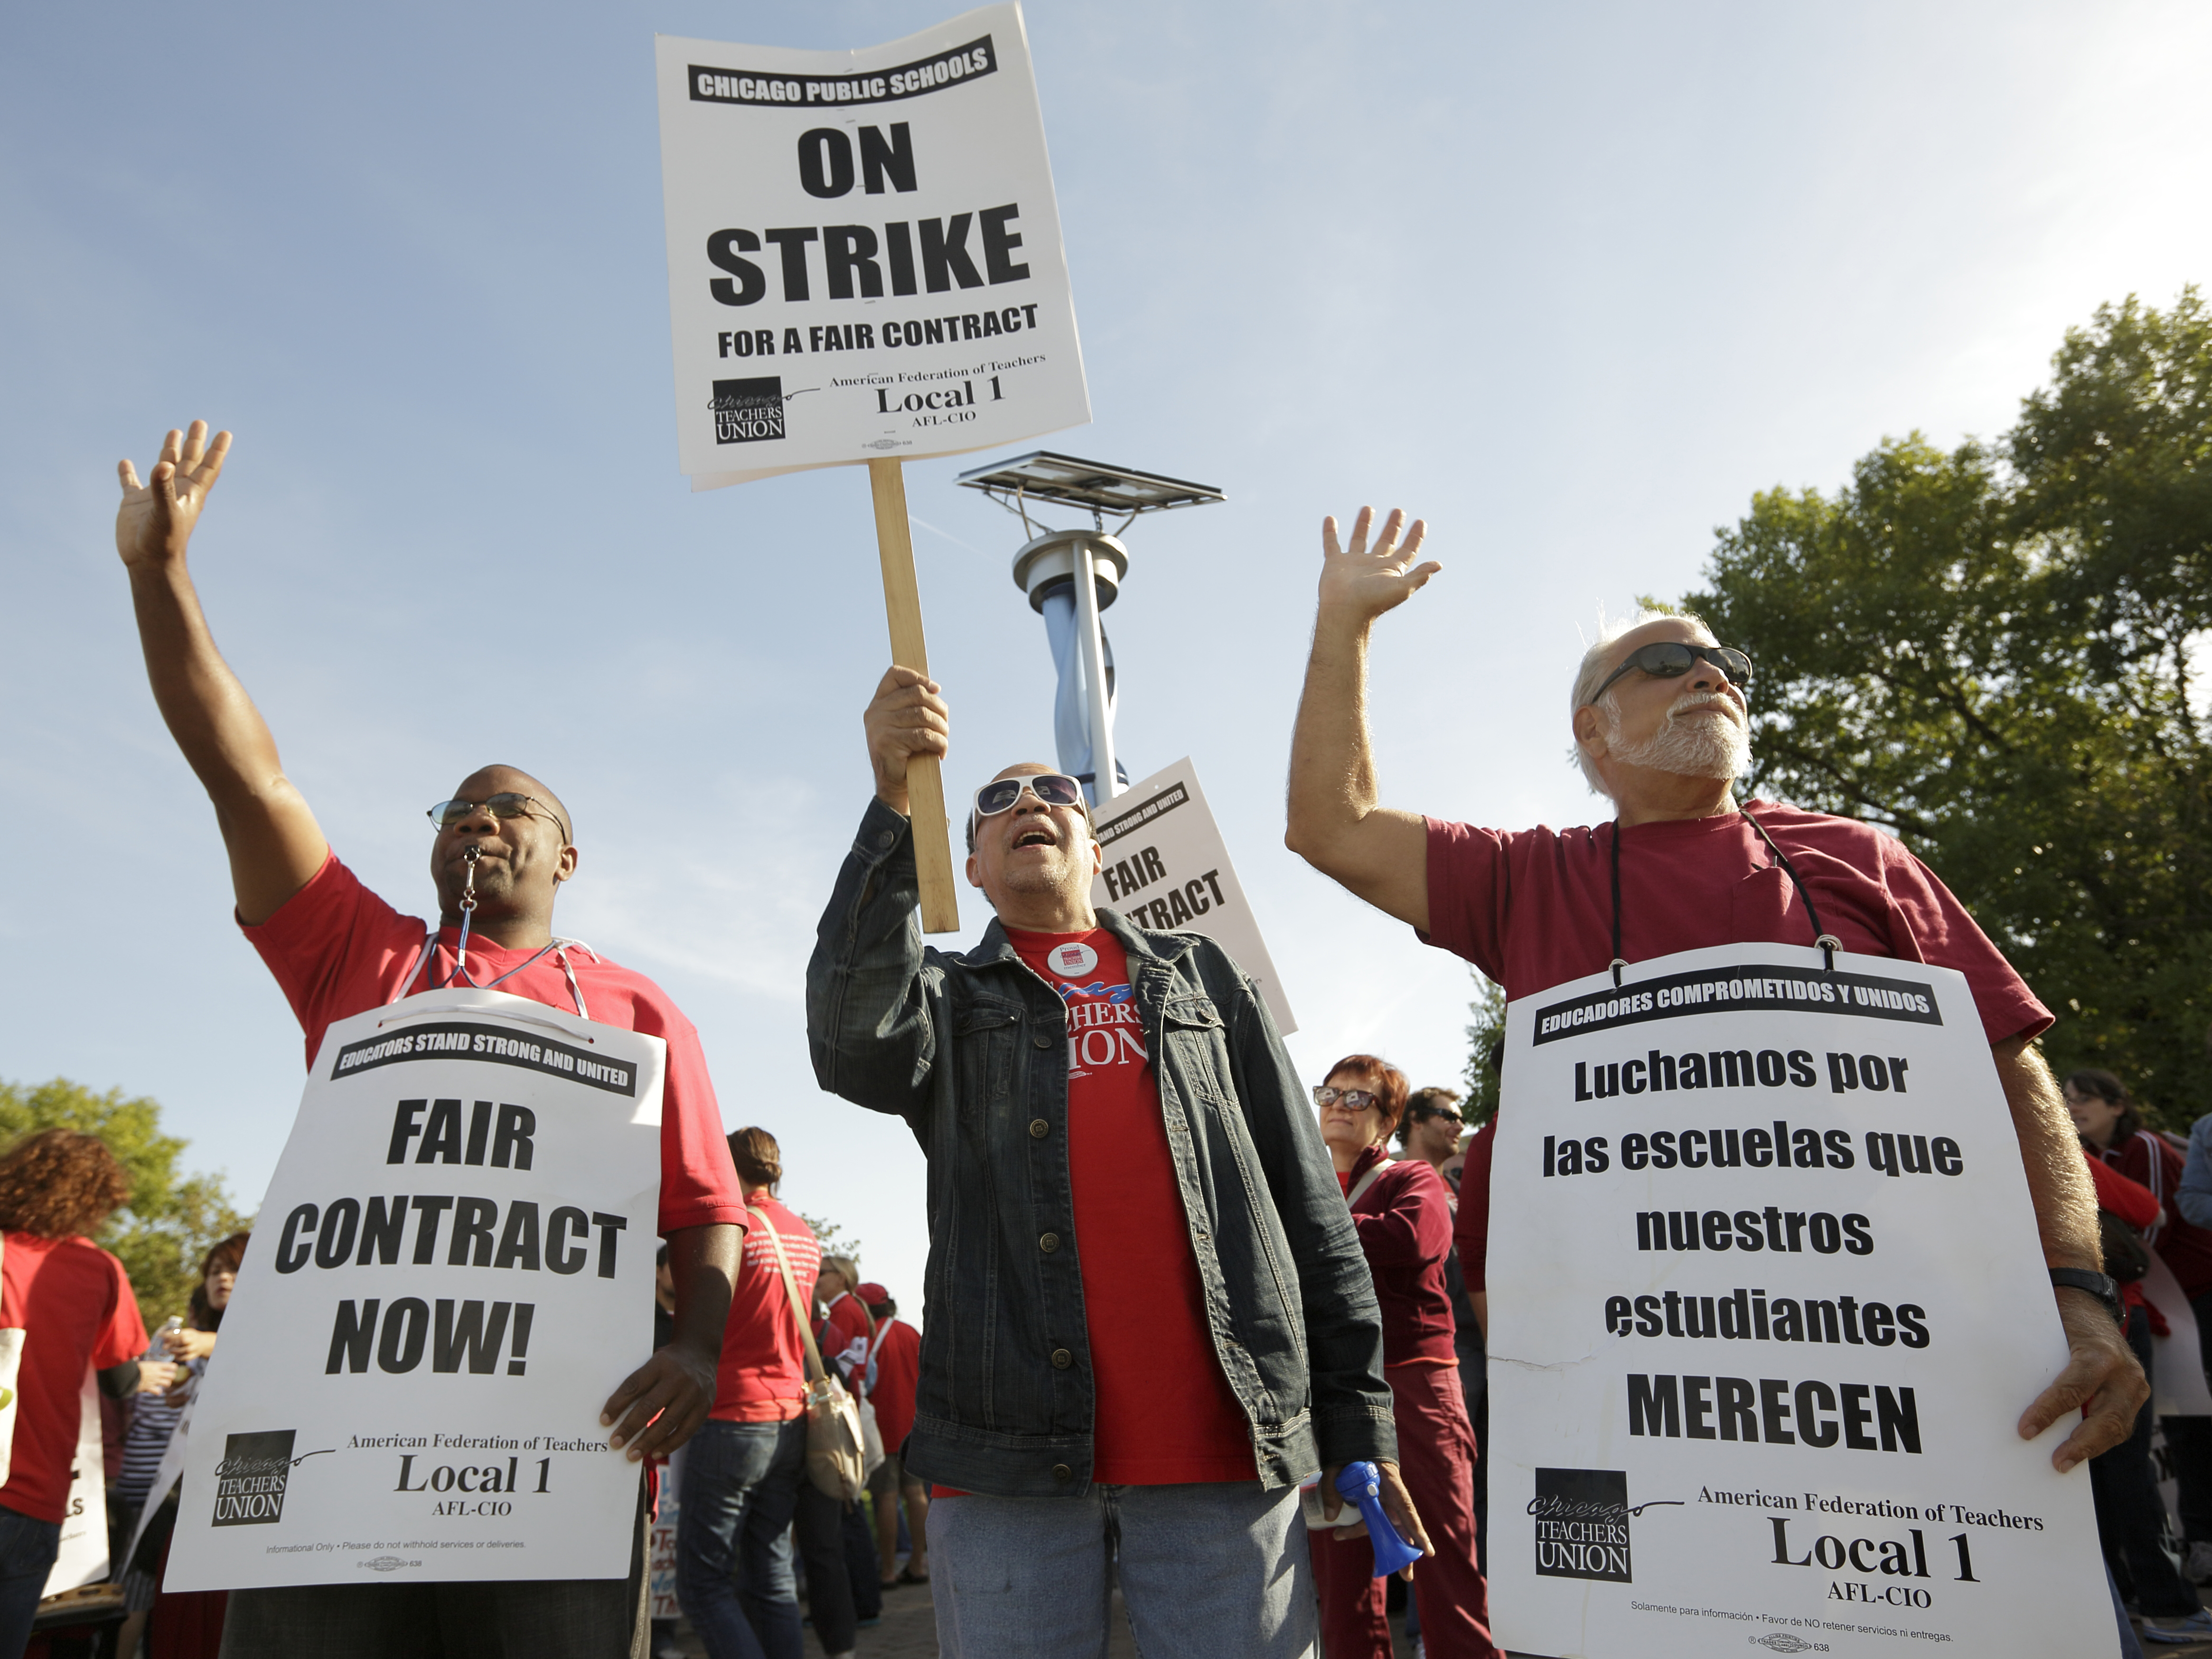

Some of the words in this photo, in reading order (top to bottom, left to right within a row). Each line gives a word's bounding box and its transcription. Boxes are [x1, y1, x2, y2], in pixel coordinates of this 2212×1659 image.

[697, 73, 801, 102] CHICAGO
[806, 77, 886, 102] PUBLIC
[890, 47, 989, 92] SCHOOLS
[797, 122, 918, 199] ON
[706, 202, 1031, 307] STRIKE
[718, 329, 775, 358] FOR
[783, 328, 803, 354] A
[809, 323, 875, 352] FAIR
[882, 303, 1038, 348] CONTRACT
[829, 375, 894, 388] American
[898, 366, 970, 384] Federation
[972, 363, 986, 375] of
[988, 353, 1047, 372] Teachers
[715, 406, 783, 423] TEACHERS
[876, 376, 976, 414] Local
[989, 375, 1006, 402] 1
[717, 419, 783, 440] UNION
[912, 410, 976, 428] AFL-CIO
[1114, 812, 1143, 834] STRONG
[1142, 803, 1158, 820] AND
[1156, 789, 1184, 811] UNITED
[1102, 846, 1167, 902] FAIR
[1125, 868, 1226, 929] TRACT
[1540, 994, 1653, 1035] EDUCADORES
[1657, 979, 1835, 1009] COMPROMETIDOS
[1837, 984, 1851, 1005] Y
[1853, 985, 1930, 1014] UNIDOS
[338, 1036, 414, 1071] EDUCATORS
[415, 1033, 470, 1052] STAND
[473, 1035, 542, 1062] STRONG
[542, 1048, 574, 1071] AND
[576, 1059, 629, 1087] UNITED
[1574, 1049, 1817, 1102] Luchamos
[1826, 1052, 1909, 1094] por
[386, 1099, 537, 1171] FAIR
[1543, 1134, 1610, 1177] las
[1620, 1120, 1855, 1171] escuelas
[1866, 1131, 1964, 1177] que
[275, 1195, 628, 1280] CONTRACT
[1636, 1206, 1874, 1256] nuestros
[325, 1297, 535, 1377] NOW!
[1604, 1288, 1931, 1349] estudiantes
[1626, 1373, 1922, 1454] MERECEN
[347, 1433, 427, 1449] American
[432, 1434, 518, 1450] Federation
[524, 1436, 540, 1451] of
[542, 1436, 608, 1452] Teachers
[220, 1475, 286, 1495] TEACHERS
[393, 1454, 518, 1493] Local
[532, 1457, 551, 1493] 1
[216, 1493, 283, 1520] UNION
[431, 1500, 512, 1516] AFL-CIO
[1527, 1494, 1685, 1526] Chicago
[1697, 1485, 1799, 1510] American
[1803, 1492, 1919, 1519] Federation
[1924, 1504, 1946, 1522] of
[1950, 1505, 2044, 1531] Teachers
[266, 1544, 314, 1554] Informational
[316, 1542, 335, 1553] Only
[342, 1542, 371, 1550] Please
[487, 1540, 526, 1548] deliveries.
[1537, 1520, 1627, 1545] TEACHERS
[1767, 1517, 1931, 1578] Local
[1948, 1532, 1981, 1583] 1
[1537, 1541, 1628, 1574] UNION
[1827, 1581, 1932, 1608] AFL-CIO
[1631, 1601, 1677, 1613] Solamente
[1679, 1607, 1699, 1616] para
[1701, 1608, 1753, 1622] información
[1762, 1613, 1788, 1625] Favor
[1790, 1617, 1802, 1626] de
[1804, 1618, 1820, 1628] NO
[1822, 1621, 1856, 1632] retener
[1857, 1624, 1897, 1636] servicios
[1900, 1628, 1908, 1637] ni
[1910, 1631, 1954, 1642] entregas.
[1782, 1634, 1800, 1642] PRINTING
[1814, 1643, 1829, 1652] 638
